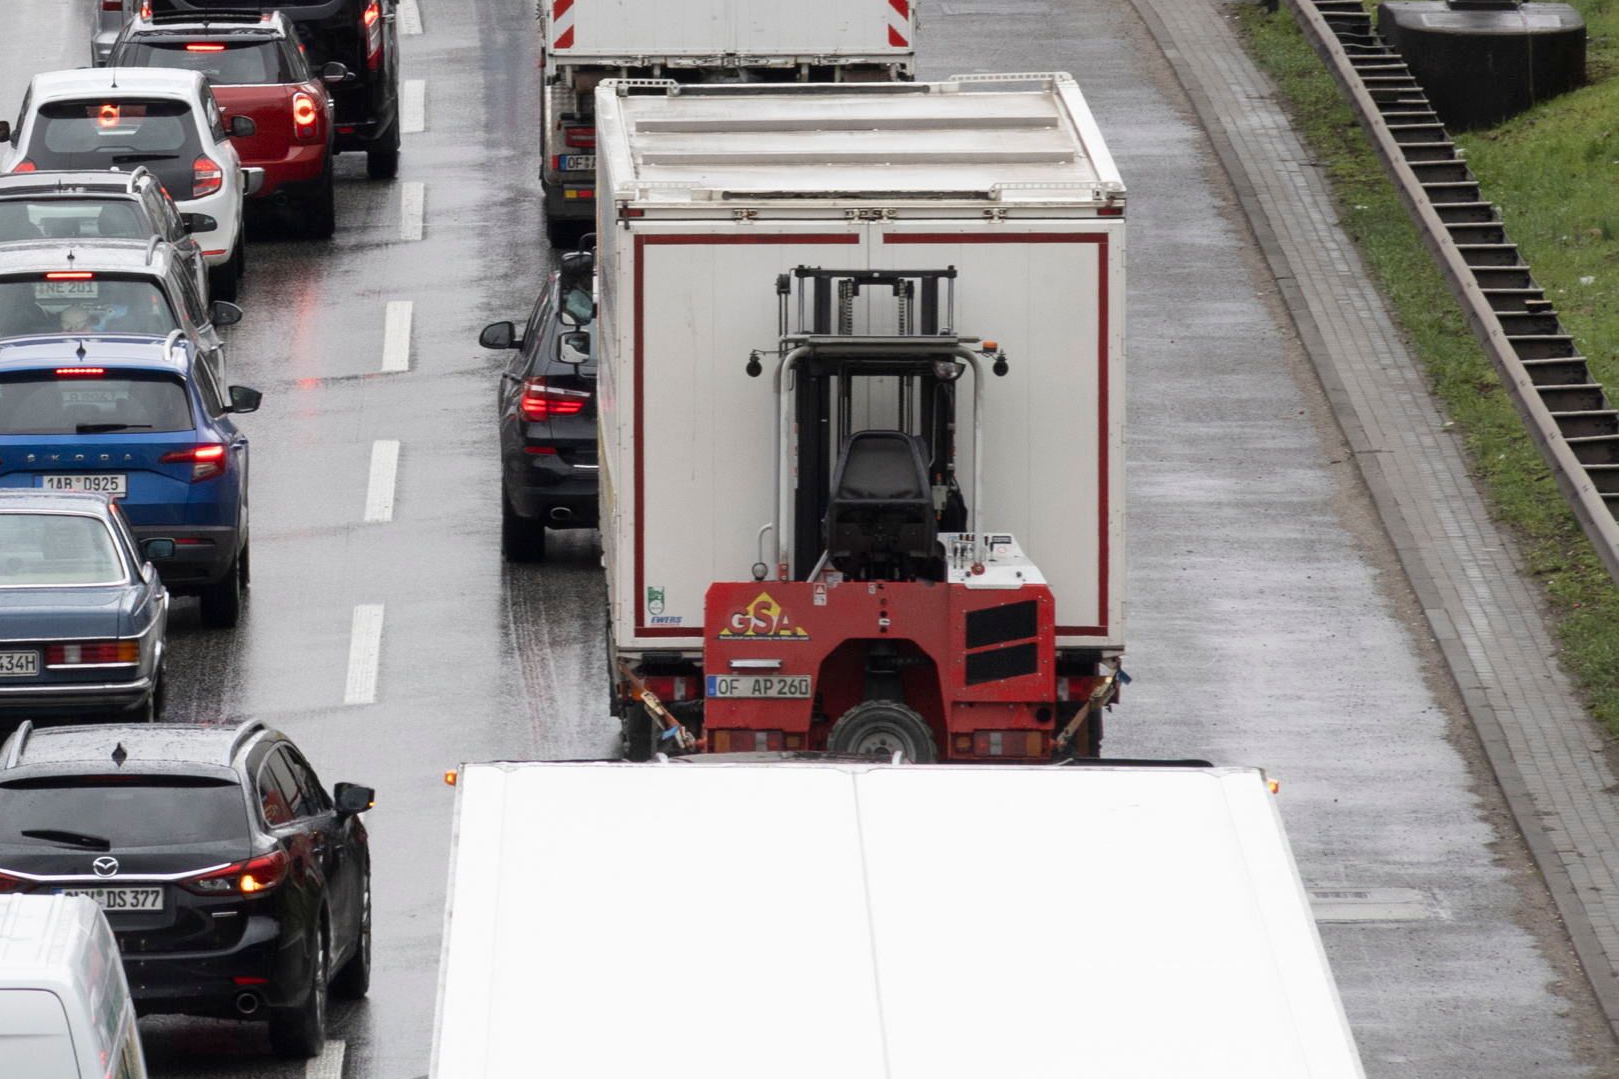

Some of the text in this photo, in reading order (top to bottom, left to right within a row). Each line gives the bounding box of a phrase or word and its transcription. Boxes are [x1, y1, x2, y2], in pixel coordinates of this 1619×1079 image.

[568, 156, 583, 169] OF
[70, 282, 94, 294] 201
[84, 477, 119, 491] D925
[727, 600, 797, 635] GSA
[718, 679, 809, 696] OF AP 260
[107, 889, 126, 909] DS
[128, 889, 161, 909] 377
